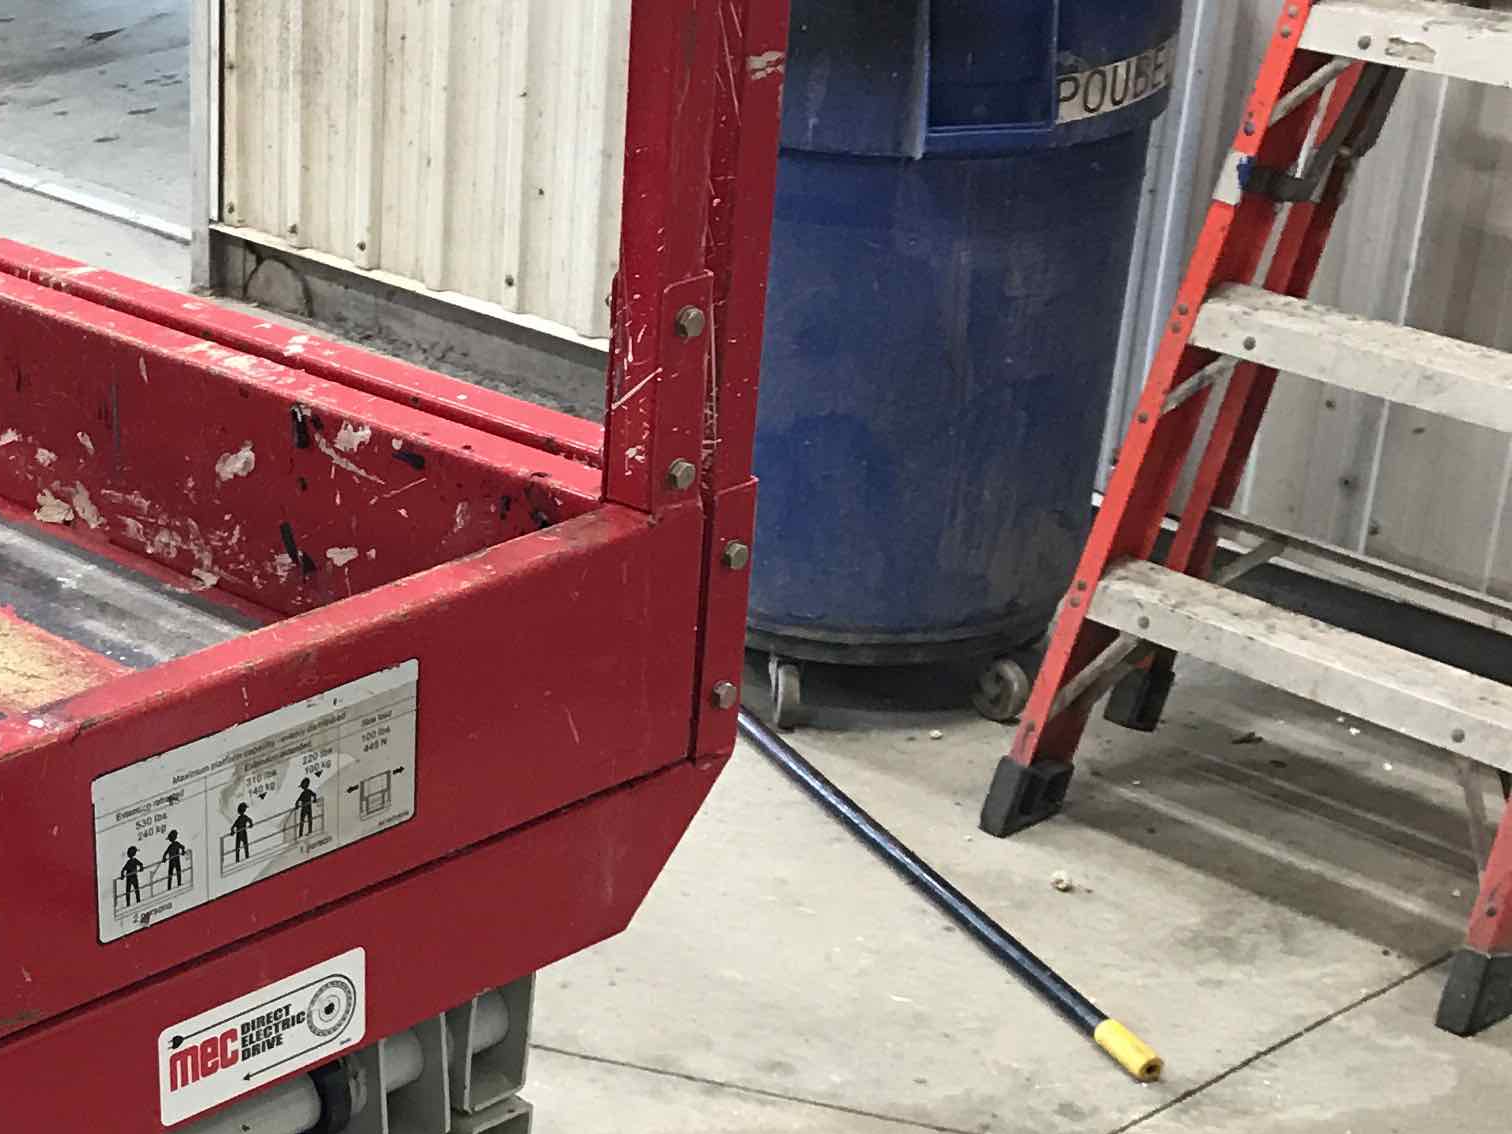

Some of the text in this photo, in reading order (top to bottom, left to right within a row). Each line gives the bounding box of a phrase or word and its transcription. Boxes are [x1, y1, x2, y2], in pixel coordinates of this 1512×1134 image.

[240, 1003, 292, 1036] DIRECT
[240, 1010, 307, 1049] ELECTRIC
[240, 1033, 284, 1062] DRIVE
